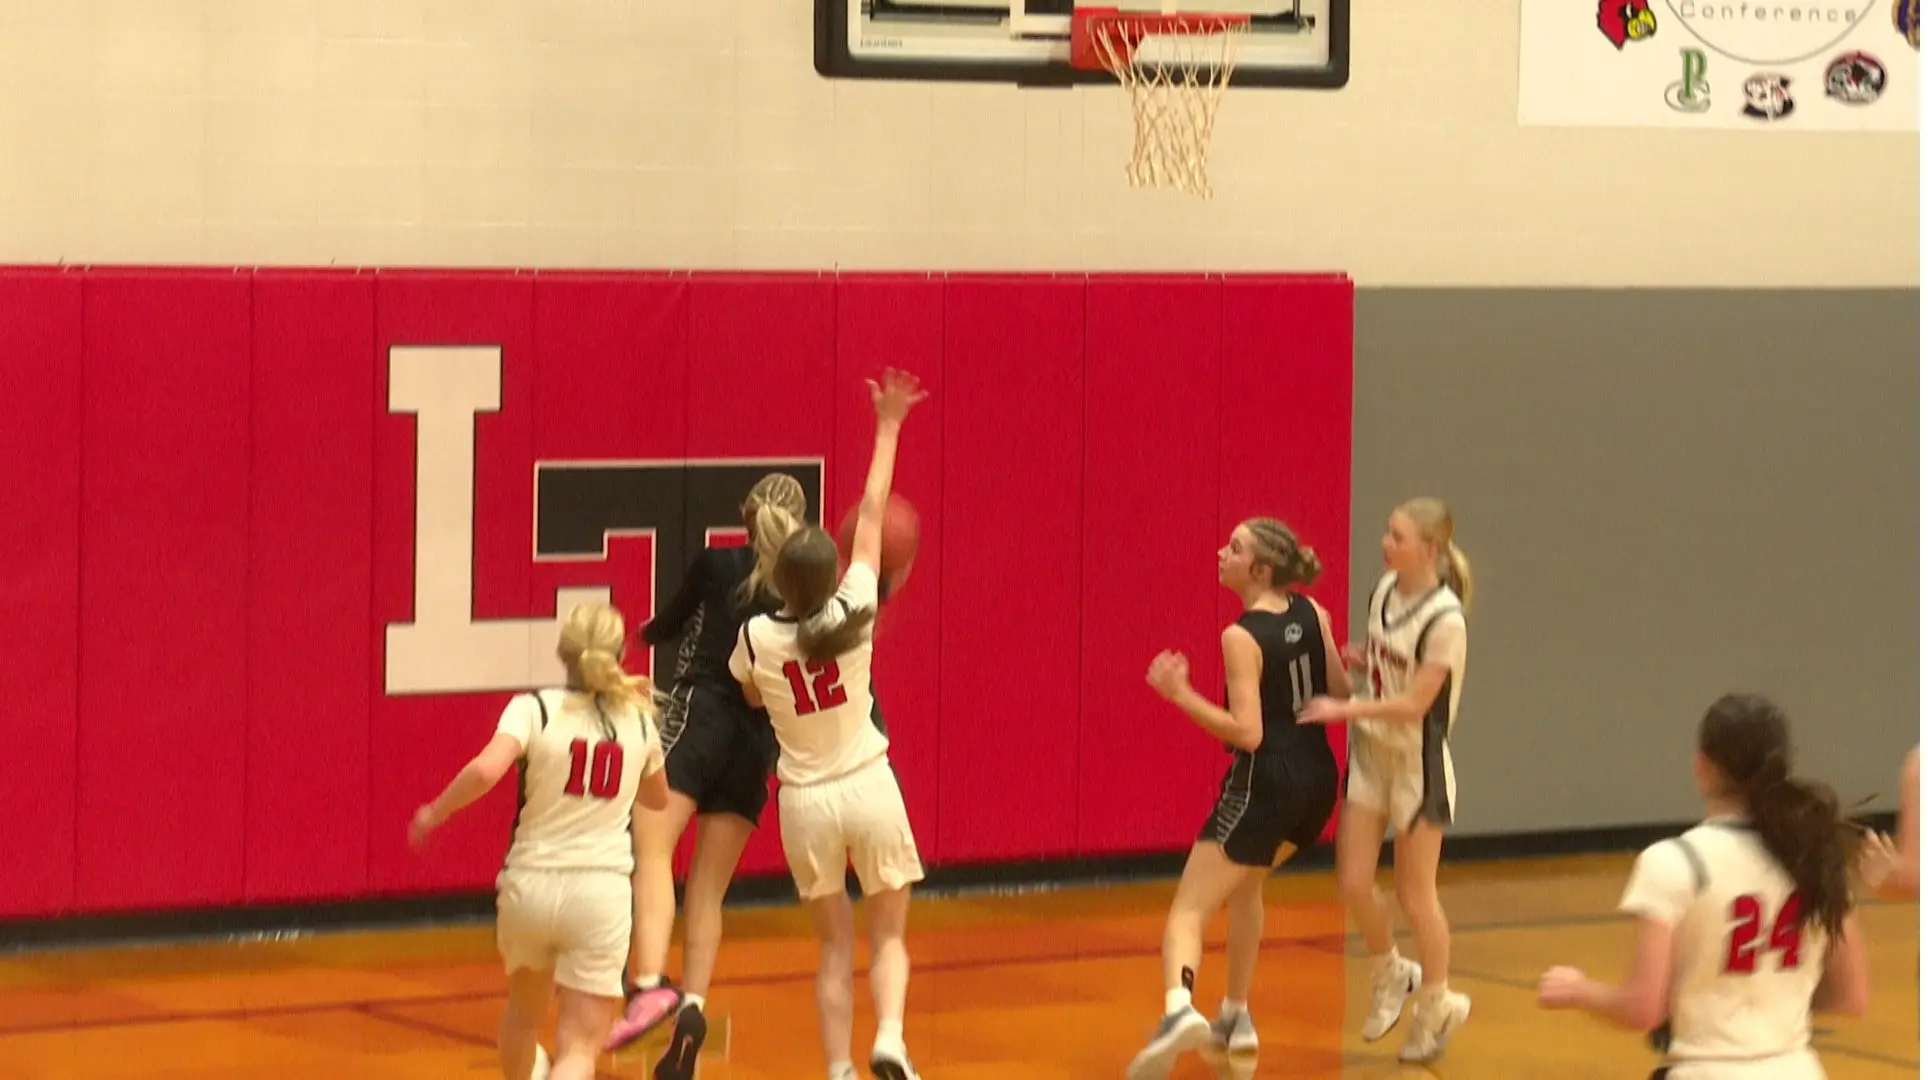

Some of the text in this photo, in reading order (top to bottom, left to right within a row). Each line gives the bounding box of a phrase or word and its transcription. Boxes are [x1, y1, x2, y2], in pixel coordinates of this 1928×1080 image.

[1680, 0, 1857, 24] Conference
[782, 657, 848, 717] 12
[1288, 652, 1314, 714] 11
[564, 737, 625, 801] 10
[1723, 893, 1805, 974] 24
